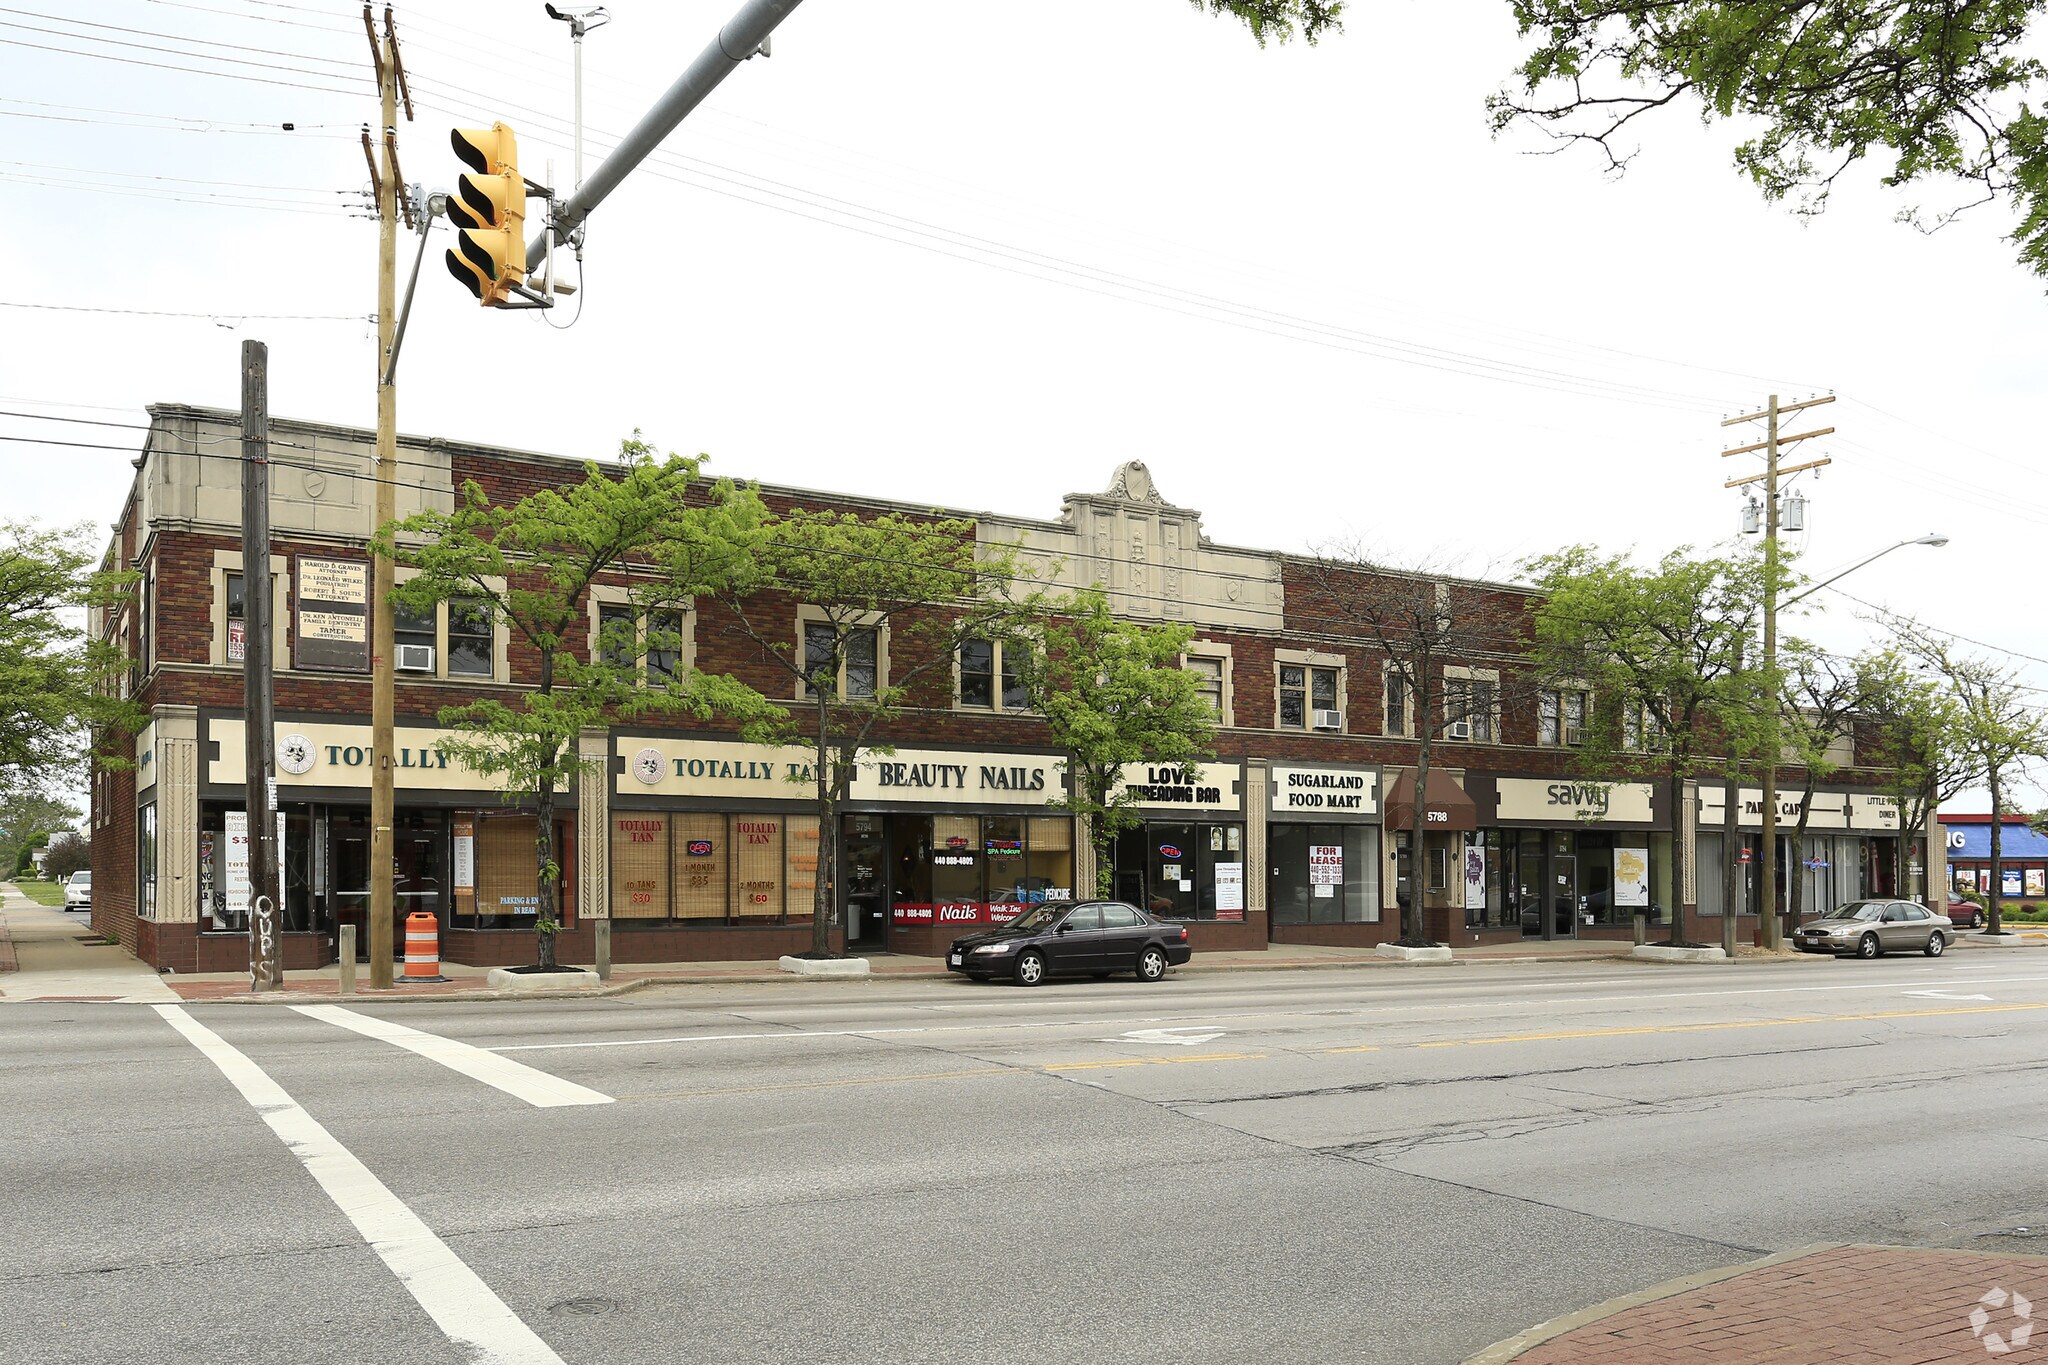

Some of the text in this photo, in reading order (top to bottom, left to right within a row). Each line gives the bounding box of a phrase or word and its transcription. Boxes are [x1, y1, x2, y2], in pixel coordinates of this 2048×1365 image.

[312, 632, 353, 640] CONSTRUCTION
[672, 758, 774, 780] TOTALLY
[878, 762, 1044, 790] BEAUTY NAILS
[1148, 767, 1195, 785] LOVE
[1288, 774, 1364, 789] SUGARLAND
[1196, 786, 1220, 803] BAR
[1288, 793, 1362, 808] FOOD MART
[1868, 797, 1886, 806] LITTLE
[1782, 802, 1800, 815] CAF
[1427, 811, 1448, 822] 5788
[619, 820, 663, 832] TOTALLY
[736, 822, 778, 834] TOTALLY
[632, 832, 654, 842] TAN
[748, 834, 770, 844] TAN
[690, 844, 710, 852] OPEN
[1162, 847, 1181, 856] OPEN
[1316, 846, 1336, 856] FOR
[934, 856, 946, 865] 440
[1310, 856, 1342, 864] LEASE
[690, 864, 715, 872] MONTH
[637, 880, 656, 888] TANS
[691, 876, 708, 886] $35
[746, 881, 774, 890] MONTHS
[632, 892, 650, 902] $30
[1046, 888, 1070, 900] PEDICURE
[500, 896, 524, 904] PARKING
[514, 906, 536, 914] IN REAR
[894, 908, 904, 918] 440
[940, 904, 977, 920] Nails
[990, 904, 1022, 912] Walk Ins
